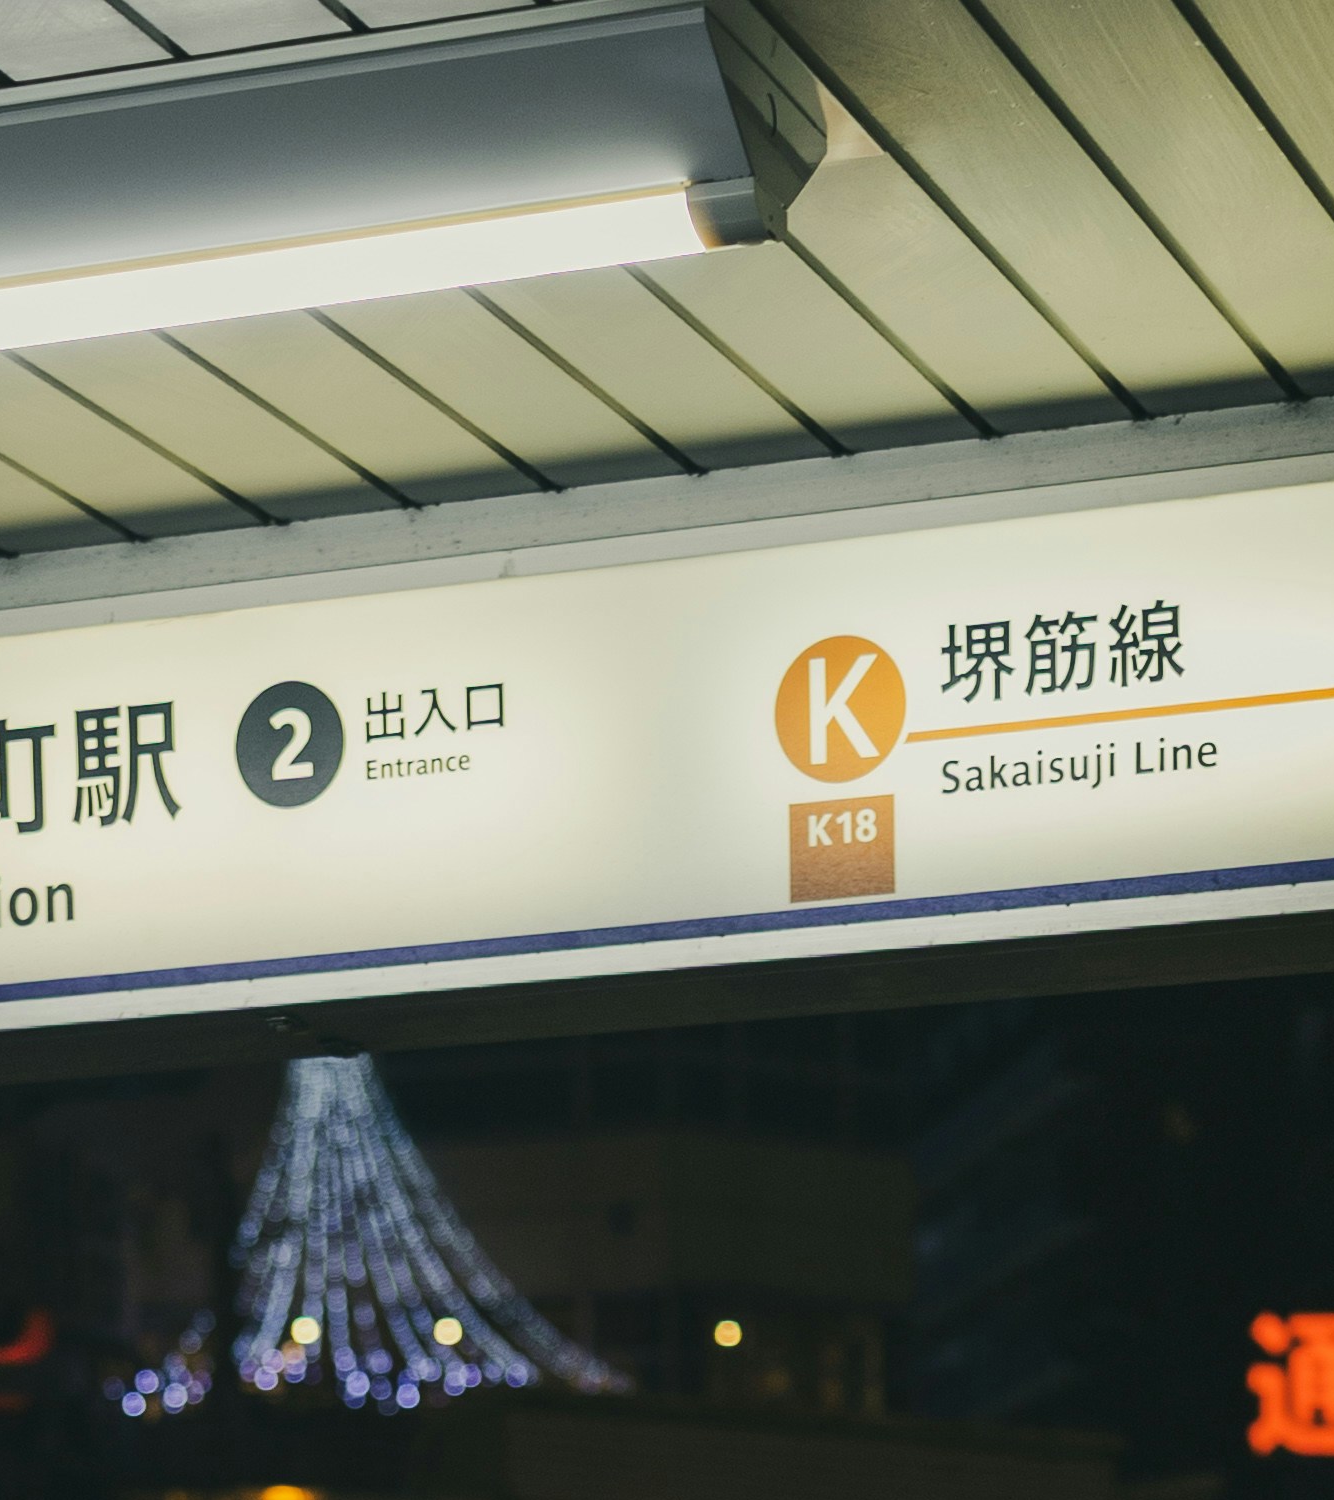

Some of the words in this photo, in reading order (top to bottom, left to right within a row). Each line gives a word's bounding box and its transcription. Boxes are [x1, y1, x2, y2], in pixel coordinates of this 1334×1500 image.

[941, 600, 1185, 703] 堺筋線
[366, 683, 504, 743] 出入口
[809, 653, 880, 766] K
[269, 707, 314, 781] 2
[366, 754, 471, 780] Entrance
[942, 743, 1116, 794] Sakaisuji
[1135, 737, 1218, 774] Line
[808, 808, 877, 847] K18
